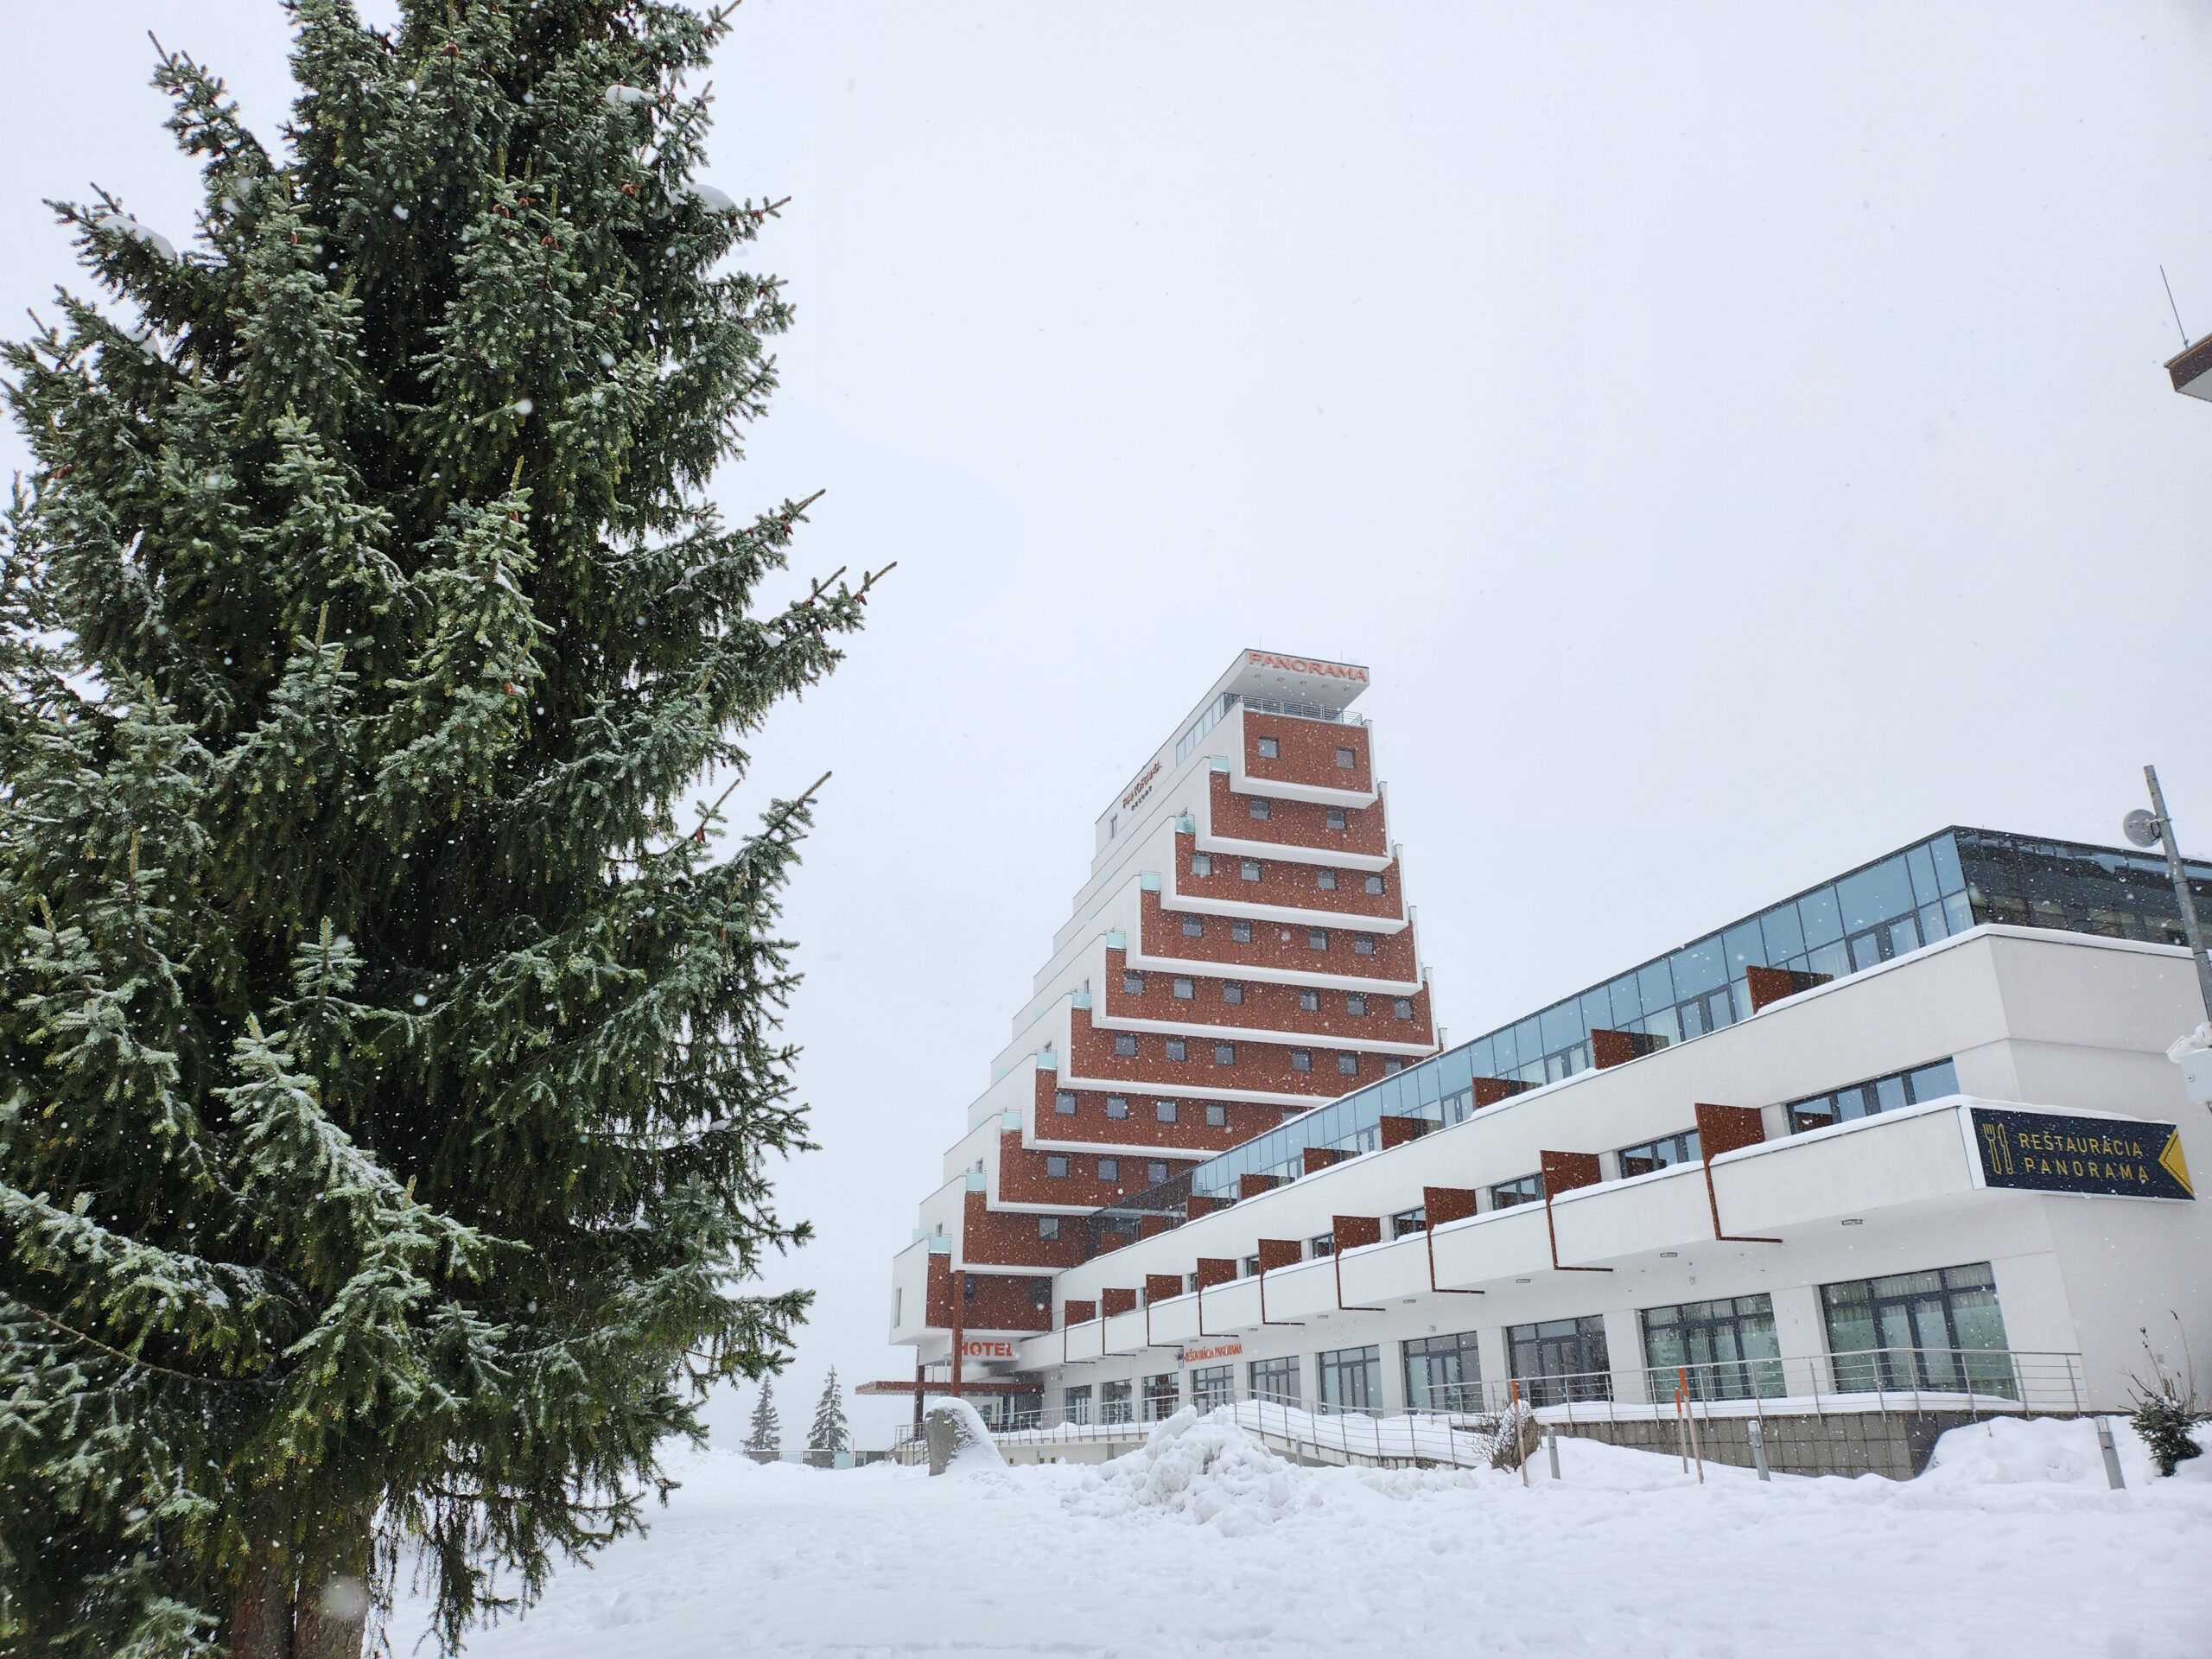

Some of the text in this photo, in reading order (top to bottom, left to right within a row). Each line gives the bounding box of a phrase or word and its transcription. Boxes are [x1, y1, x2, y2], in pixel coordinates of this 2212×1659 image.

[1249, 652, 1368, 682] PANORAMA
[2024, 1157, 2149, 1181] PANORAMA
[962, 1341, 1014, 1357] HOTEL
